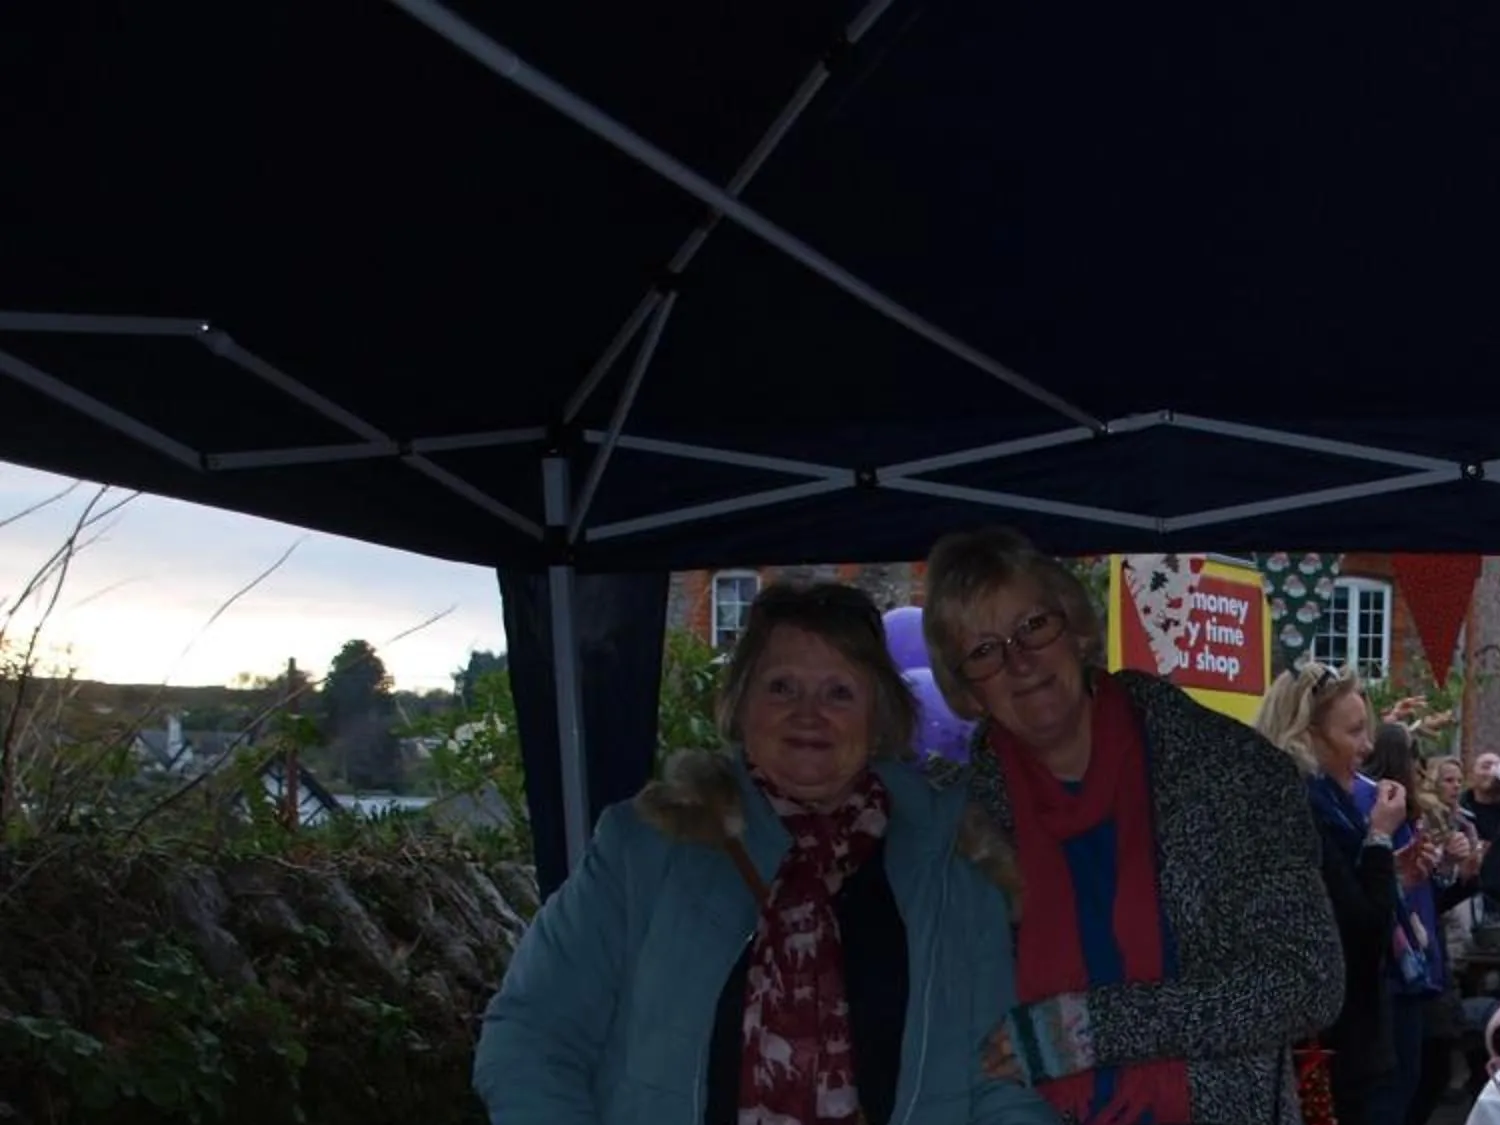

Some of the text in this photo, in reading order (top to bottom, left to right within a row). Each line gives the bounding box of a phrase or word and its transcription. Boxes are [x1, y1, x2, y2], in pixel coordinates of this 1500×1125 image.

[1192, 592, 1249, 625] money
[1205, 616, 1245, 647] time
[1196, 644, 1240, 682] shop
